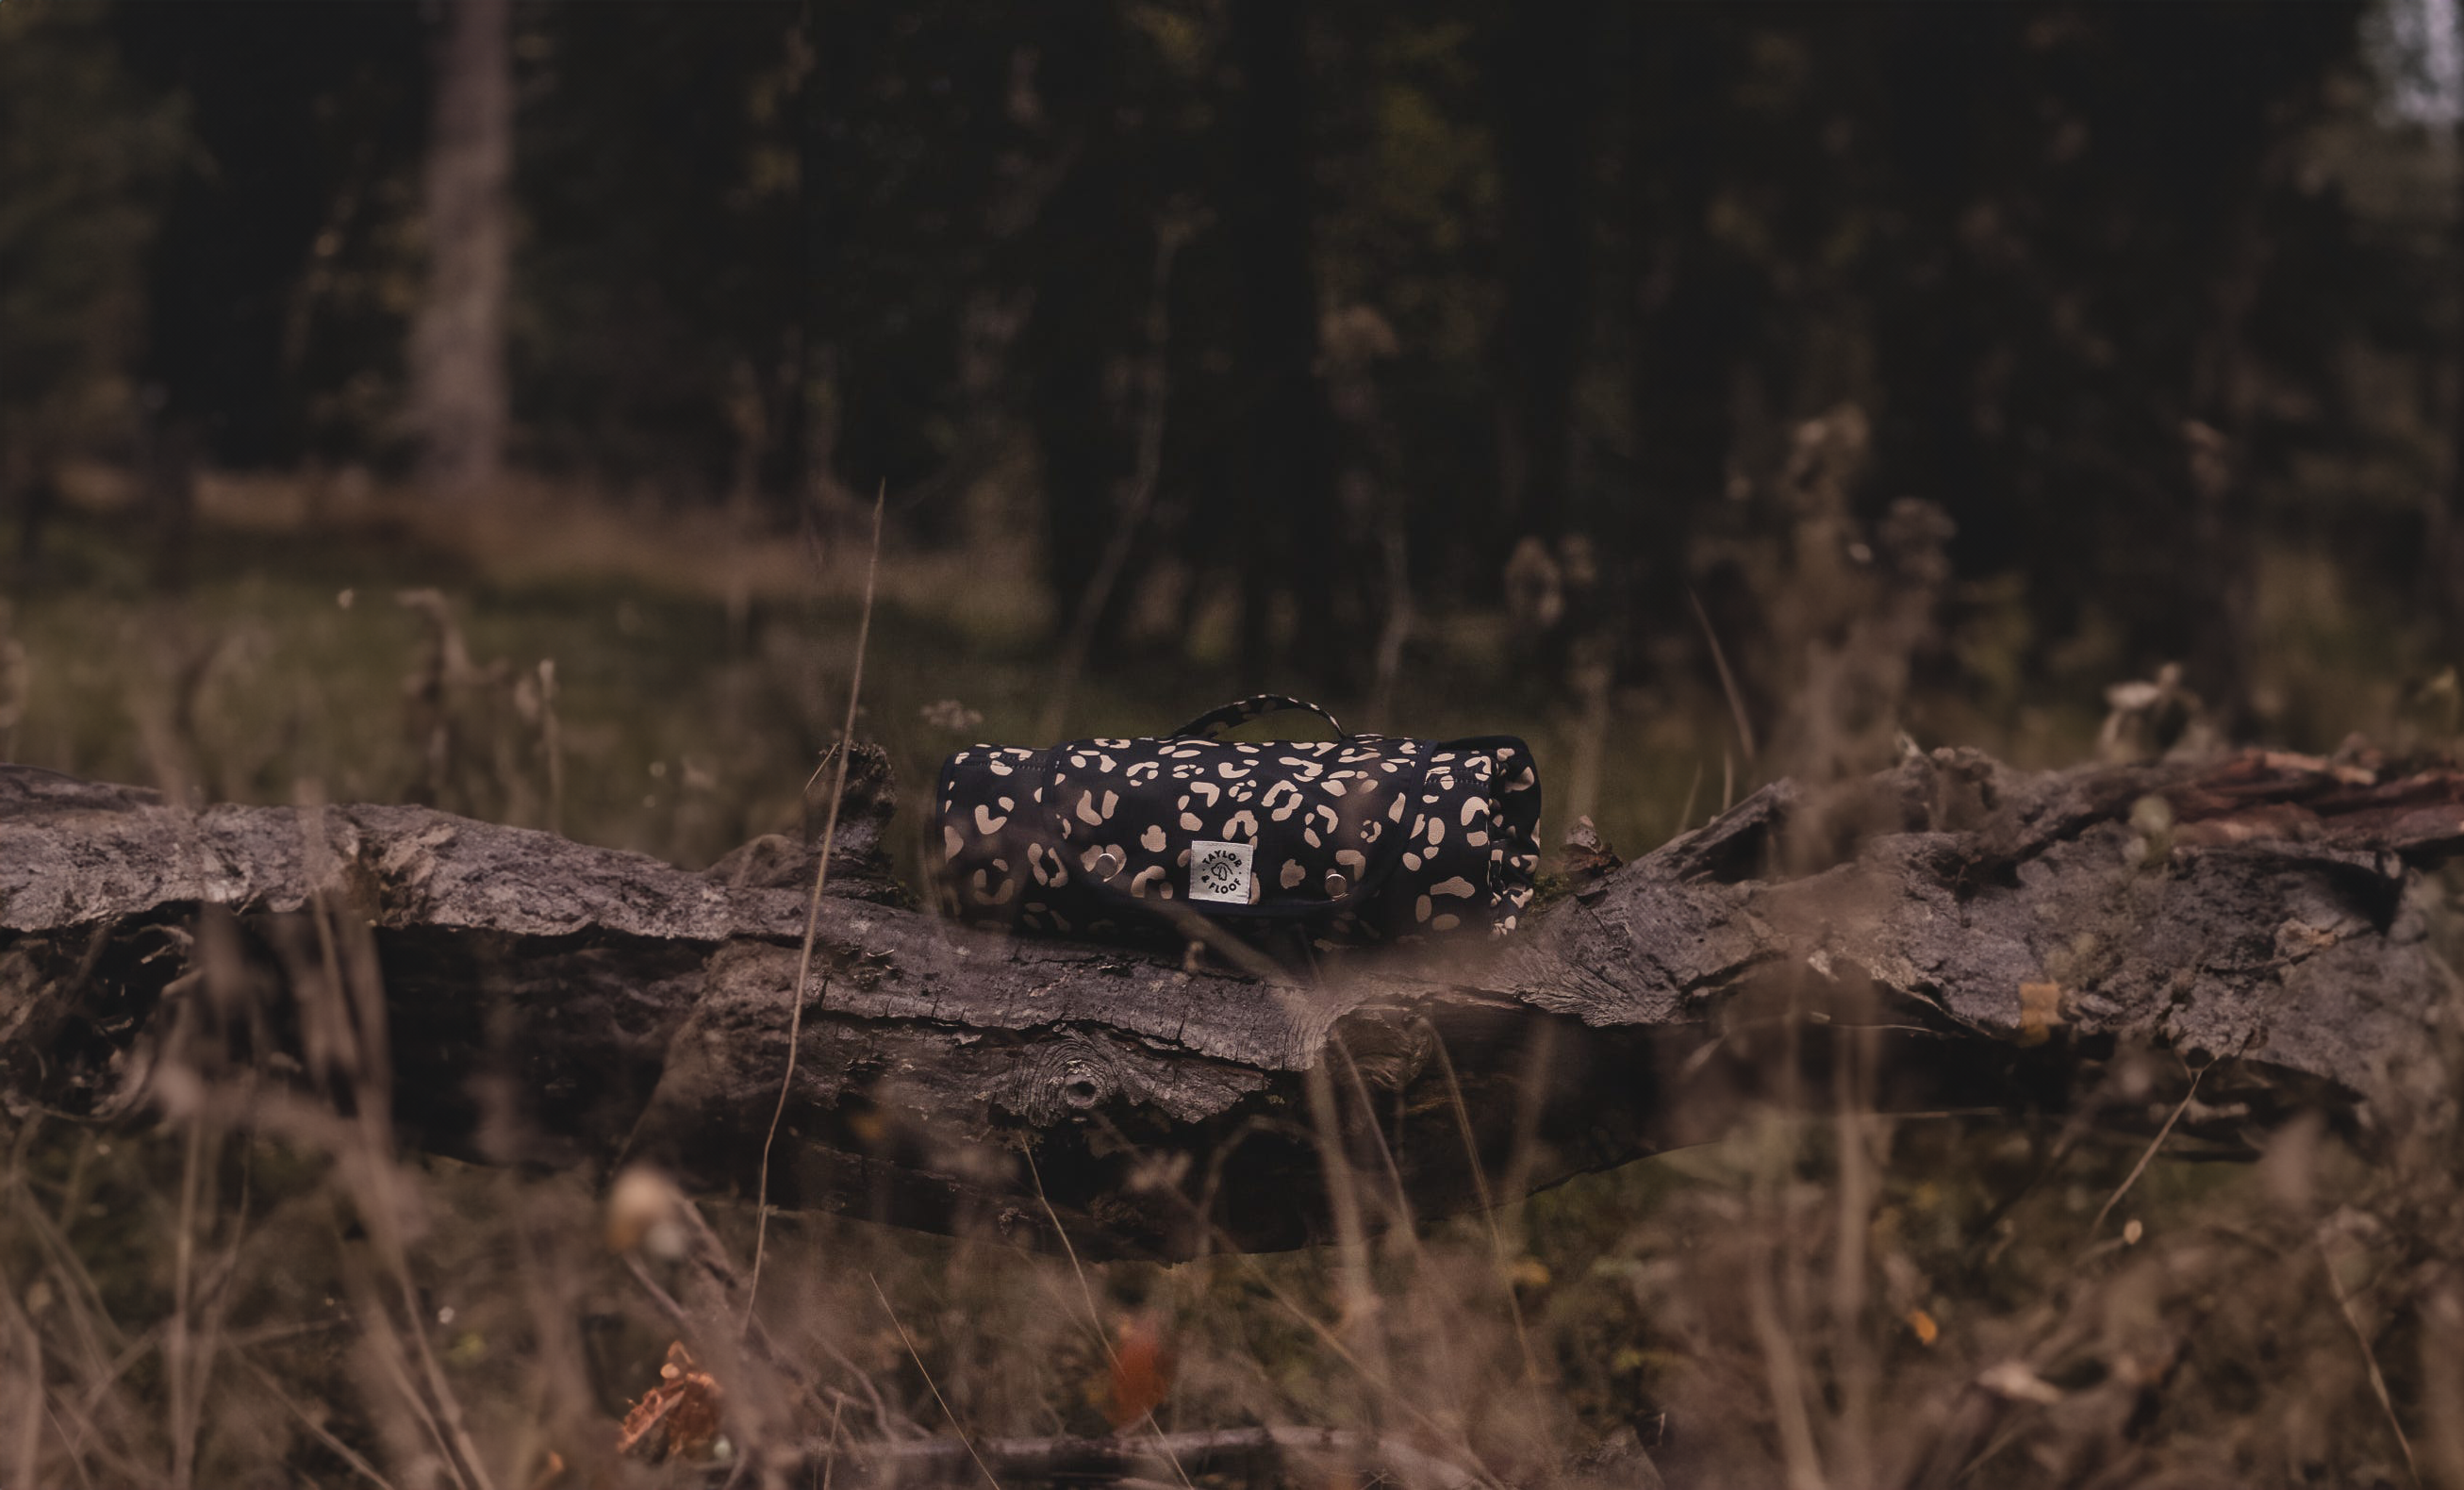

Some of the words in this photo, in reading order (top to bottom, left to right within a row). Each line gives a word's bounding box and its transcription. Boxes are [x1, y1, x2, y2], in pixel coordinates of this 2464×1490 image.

[1202, 850, 1243, 868] TAYLOR
[1201, 874, 1210, 883] &
[1209, 878, 1242, 894] FLOOF
